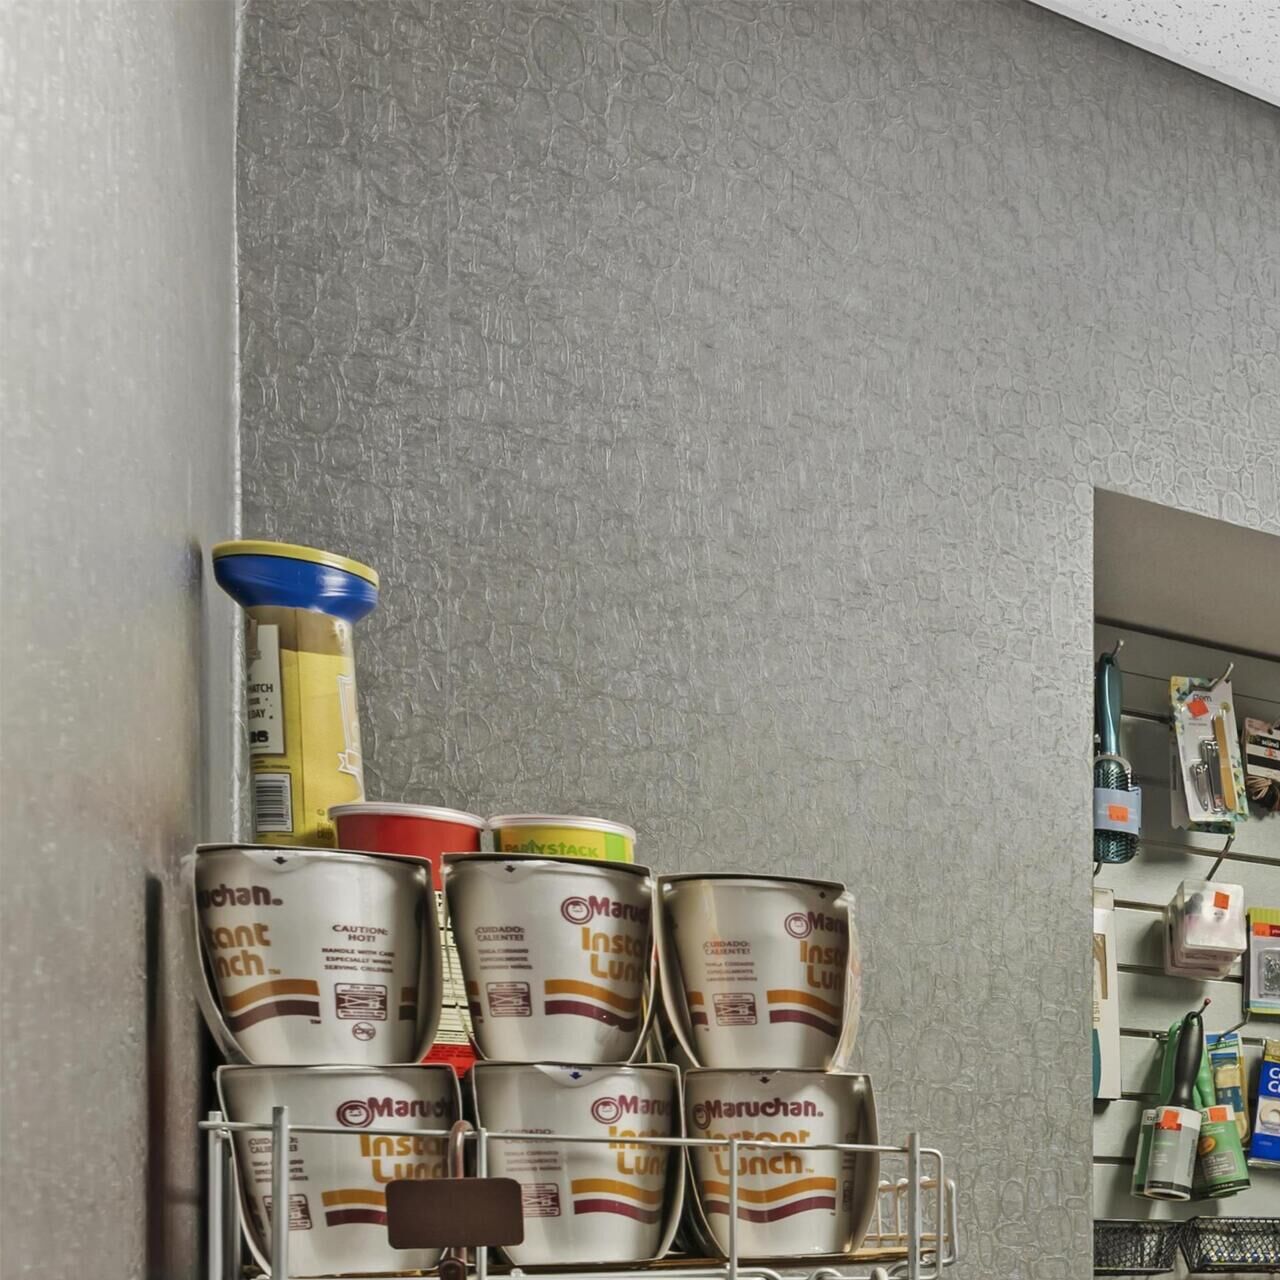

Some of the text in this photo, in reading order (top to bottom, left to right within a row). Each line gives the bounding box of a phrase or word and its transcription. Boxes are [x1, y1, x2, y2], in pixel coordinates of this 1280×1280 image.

[332, 924, 389, 936] CAUTION:
[348, 934, 376, 943] HOT!
[704, 1098, 818, 1120] Maruchan
[714, 1152, 804, 1177] Lunch
